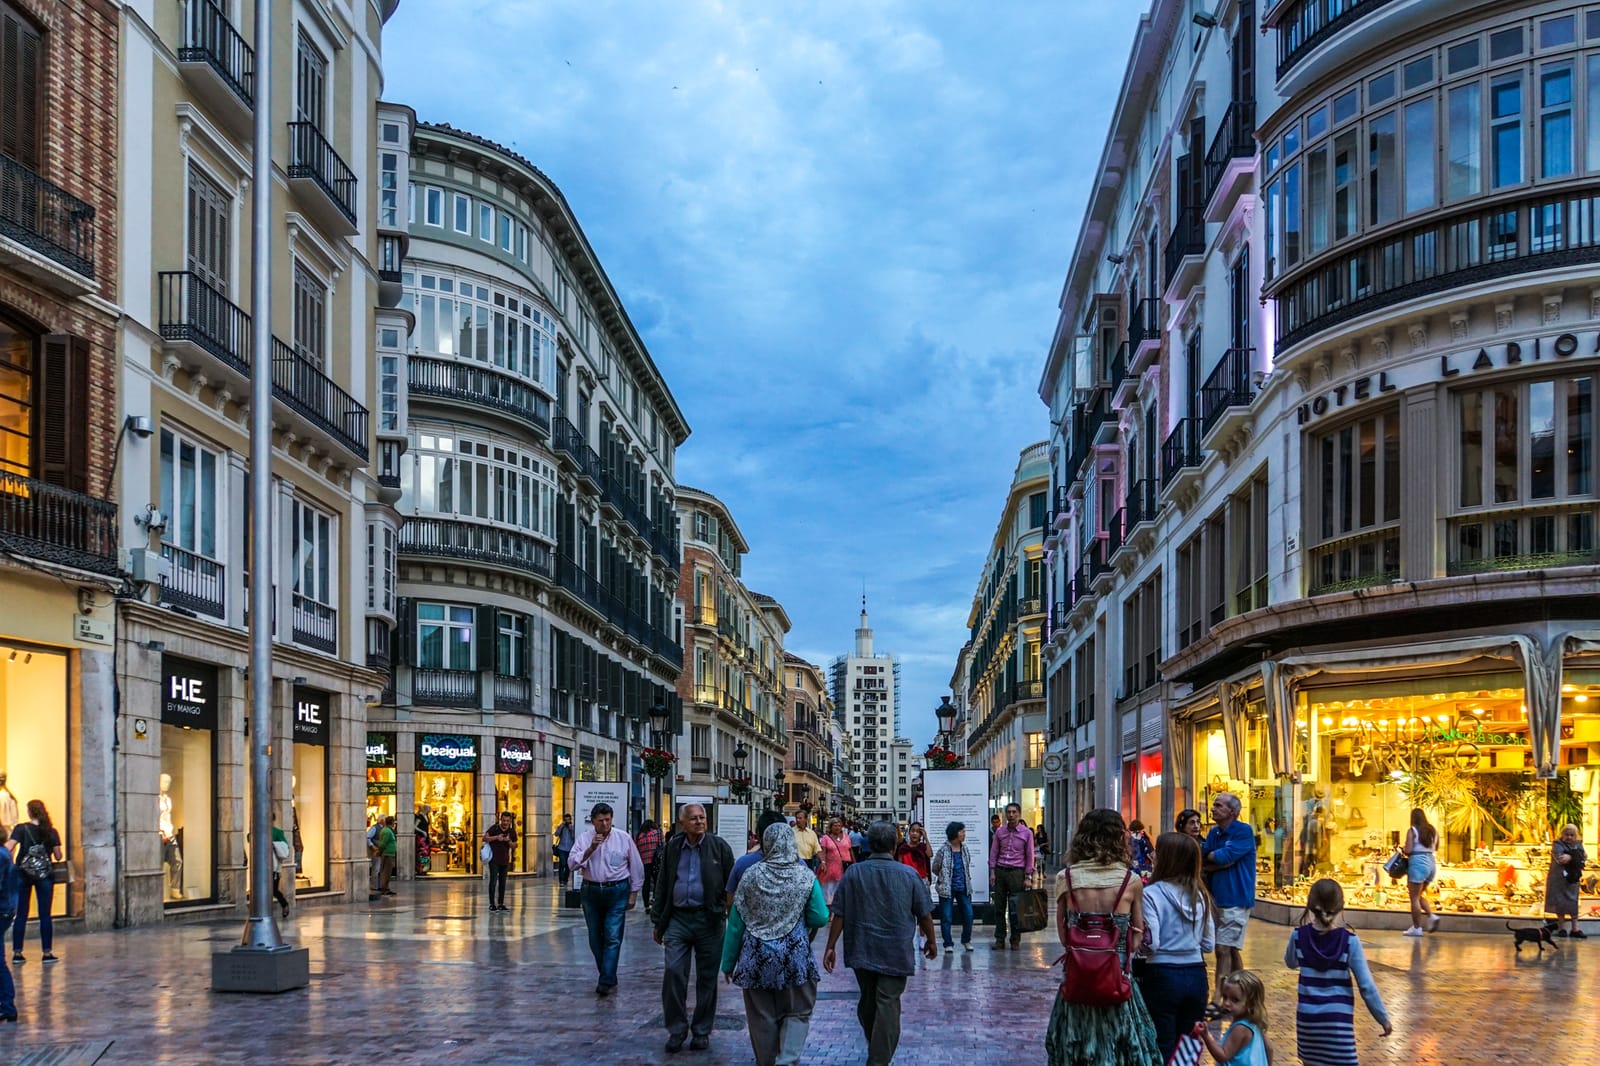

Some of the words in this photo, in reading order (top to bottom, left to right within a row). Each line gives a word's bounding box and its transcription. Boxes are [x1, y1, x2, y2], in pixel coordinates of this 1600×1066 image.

[1297, 371, 1397, 425] HOTEL
[167, 702, 177, 711] BY
[177, 704, 201, 715] MANGO
